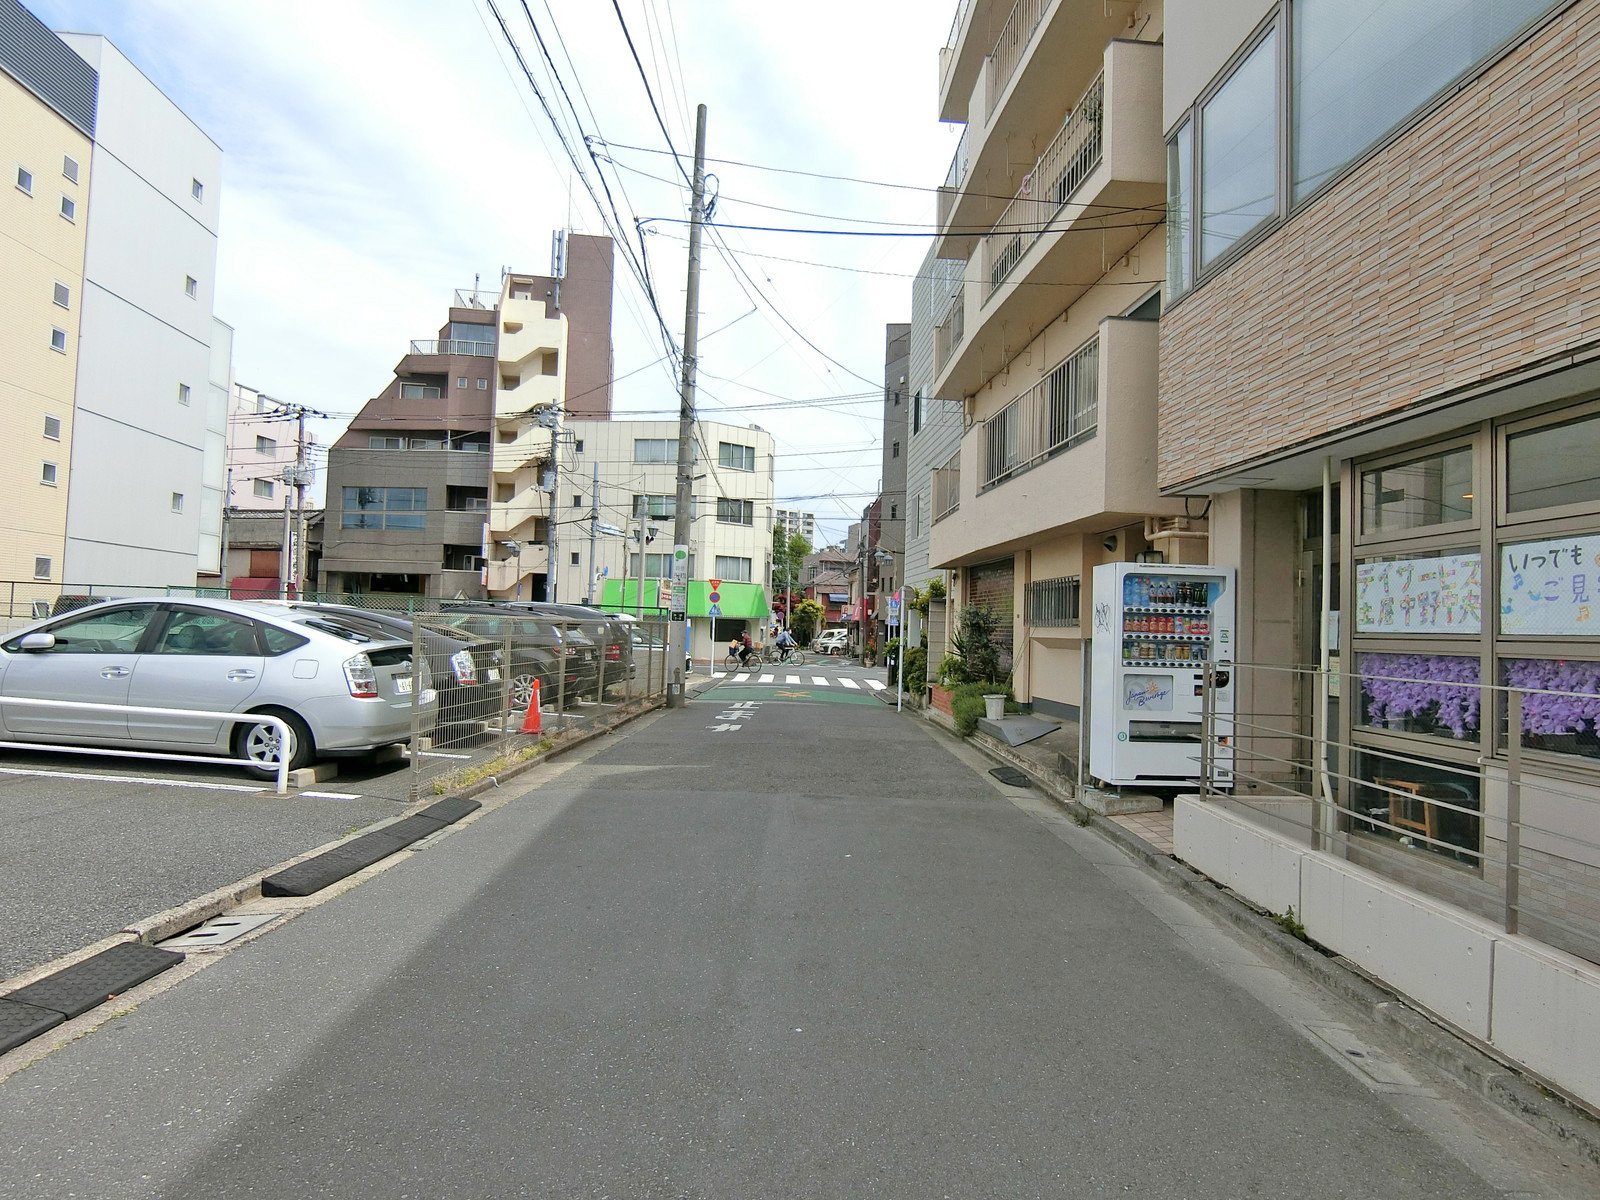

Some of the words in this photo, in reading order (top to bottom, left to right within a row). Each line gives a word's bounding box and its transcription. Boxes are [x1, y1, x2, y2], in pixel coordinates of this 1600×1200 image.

[1508, 544, 1583, 573] いつでも
[1544, 573, 1600, 604] ご見
[1136, 690, 1170, 707] Beverage
[705, 701, 763, 732] 止まれ
